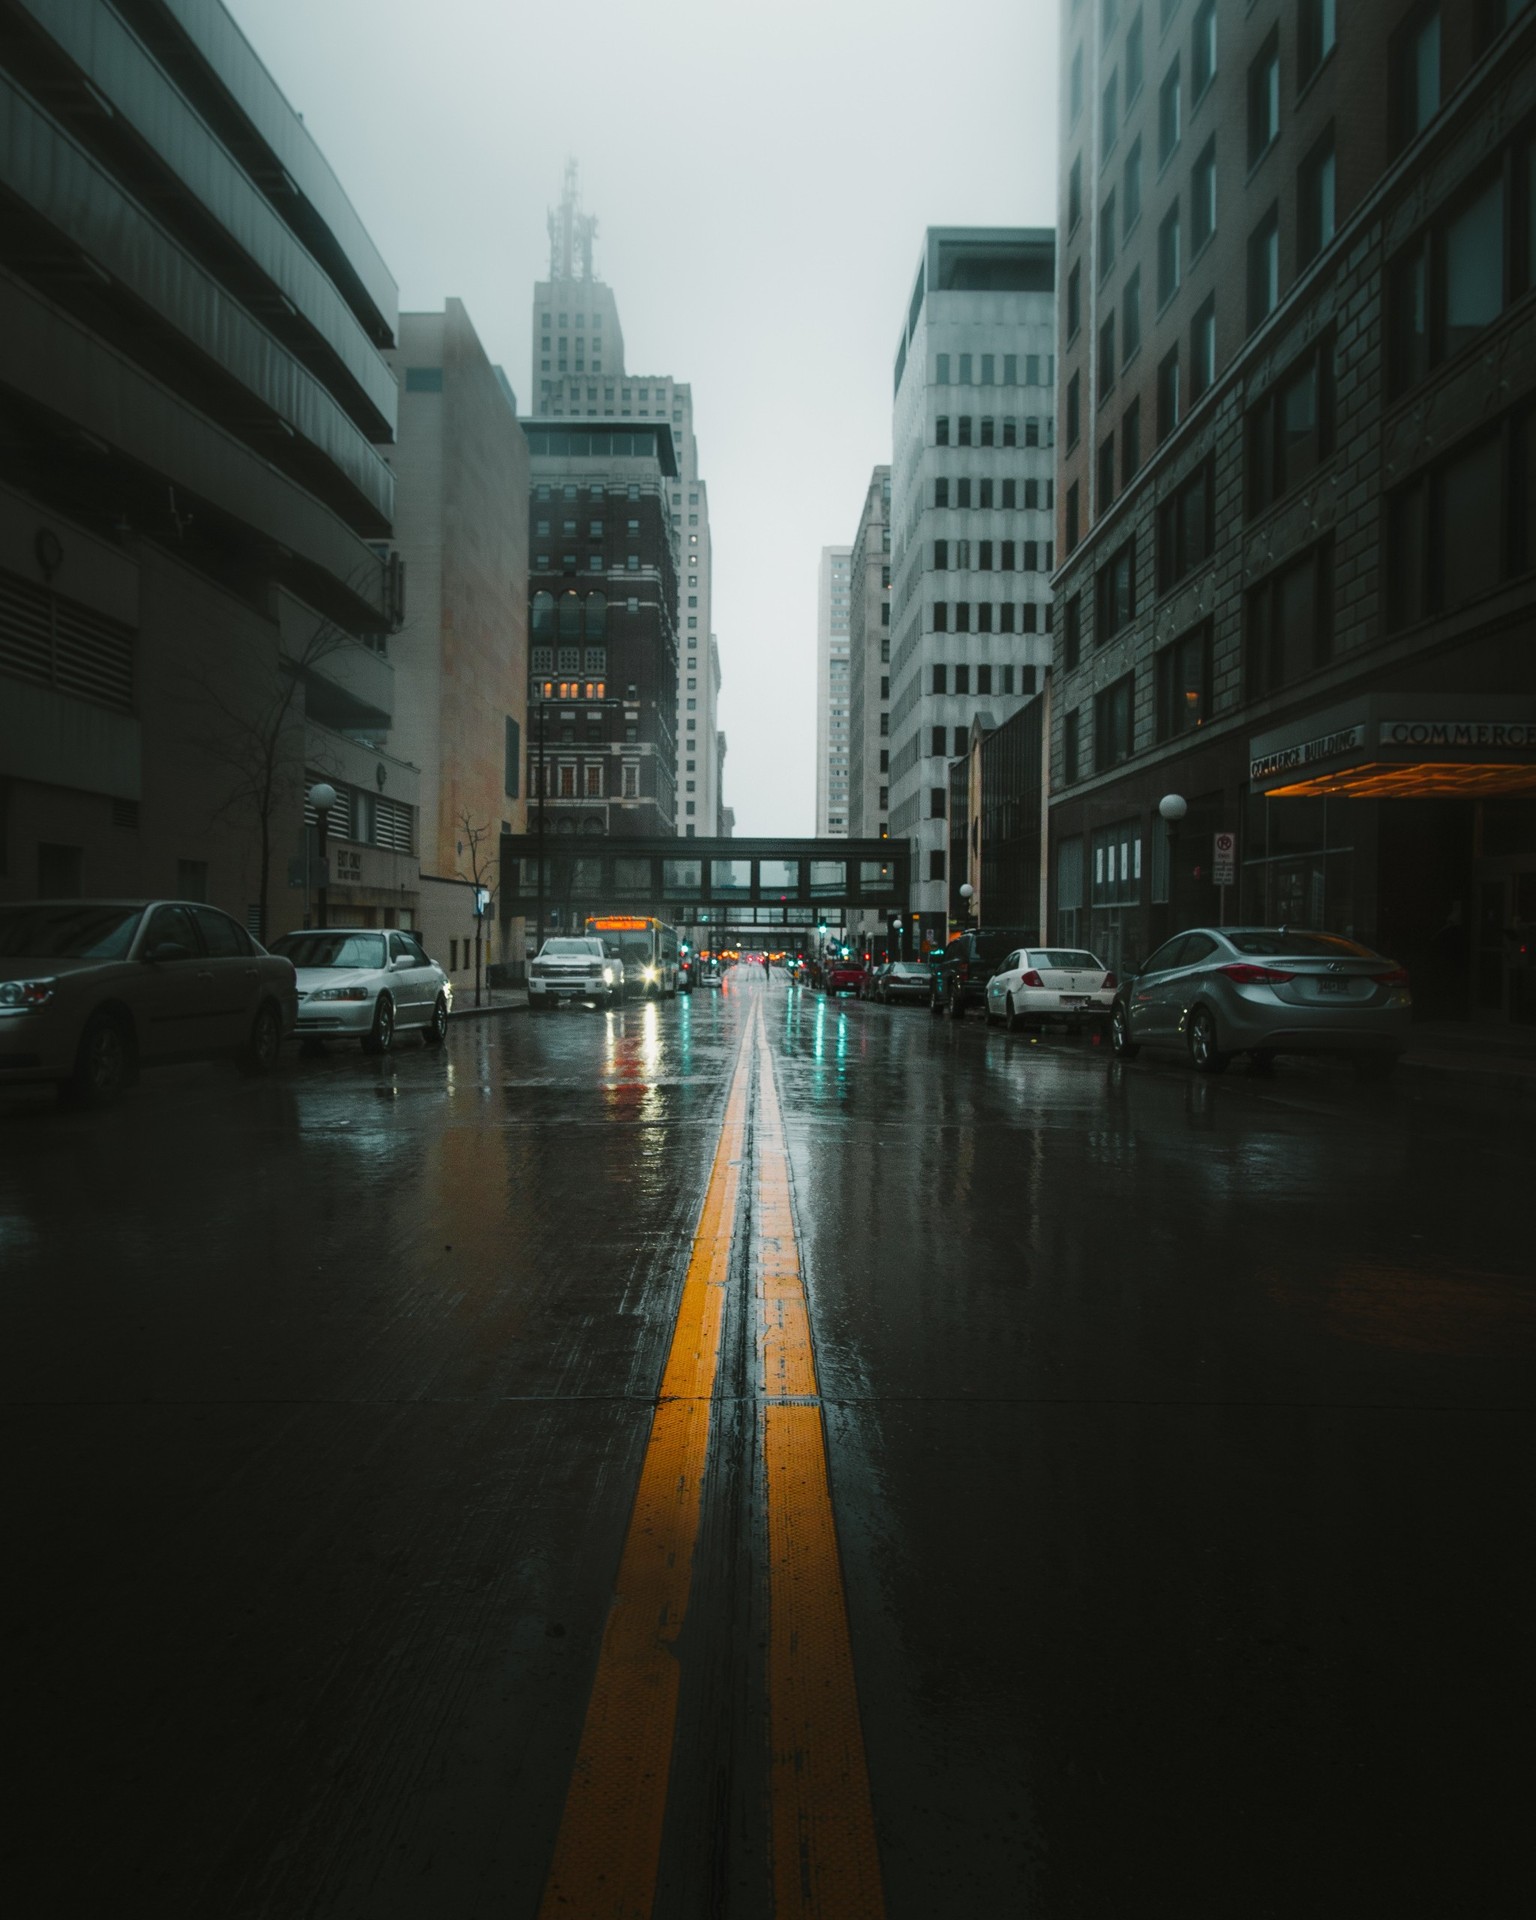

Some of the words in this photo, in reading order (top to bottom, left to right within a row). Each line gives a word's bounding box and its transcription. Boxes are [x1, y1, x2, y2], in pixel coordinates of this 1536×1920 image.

[1391, 724, 1536, 745] COMMERCE
[1252, 748, 1301, 776] COMMERCE
[1305, 730, 1356, 761] BUILDING
[338, 850, 348, 867] EXIT
